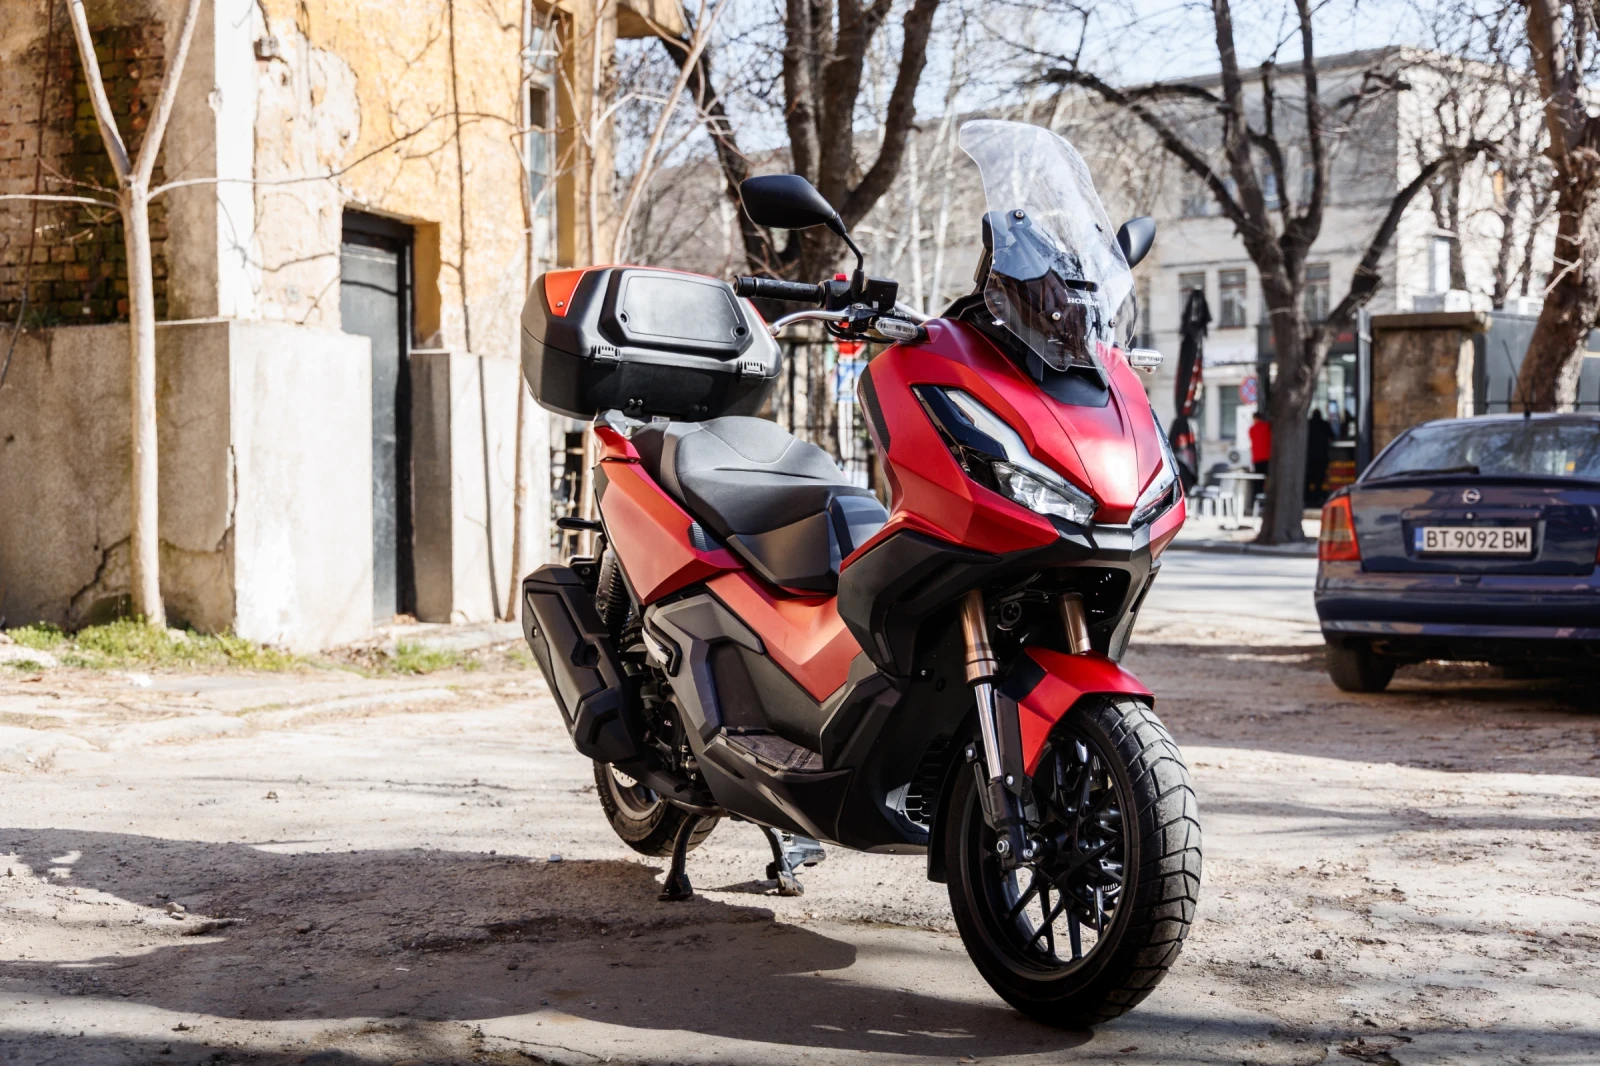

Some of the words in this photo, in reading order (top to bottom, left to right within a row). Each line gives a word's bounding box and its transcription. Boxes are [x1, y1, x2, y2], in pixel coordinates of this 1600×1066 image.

[1067, 297, 1100, 307] HONDA
[1427, 530, 1449, 548] BT
[1454, 530, 1498, 548] 9092
[1503, 531, 1527, 548] BM
